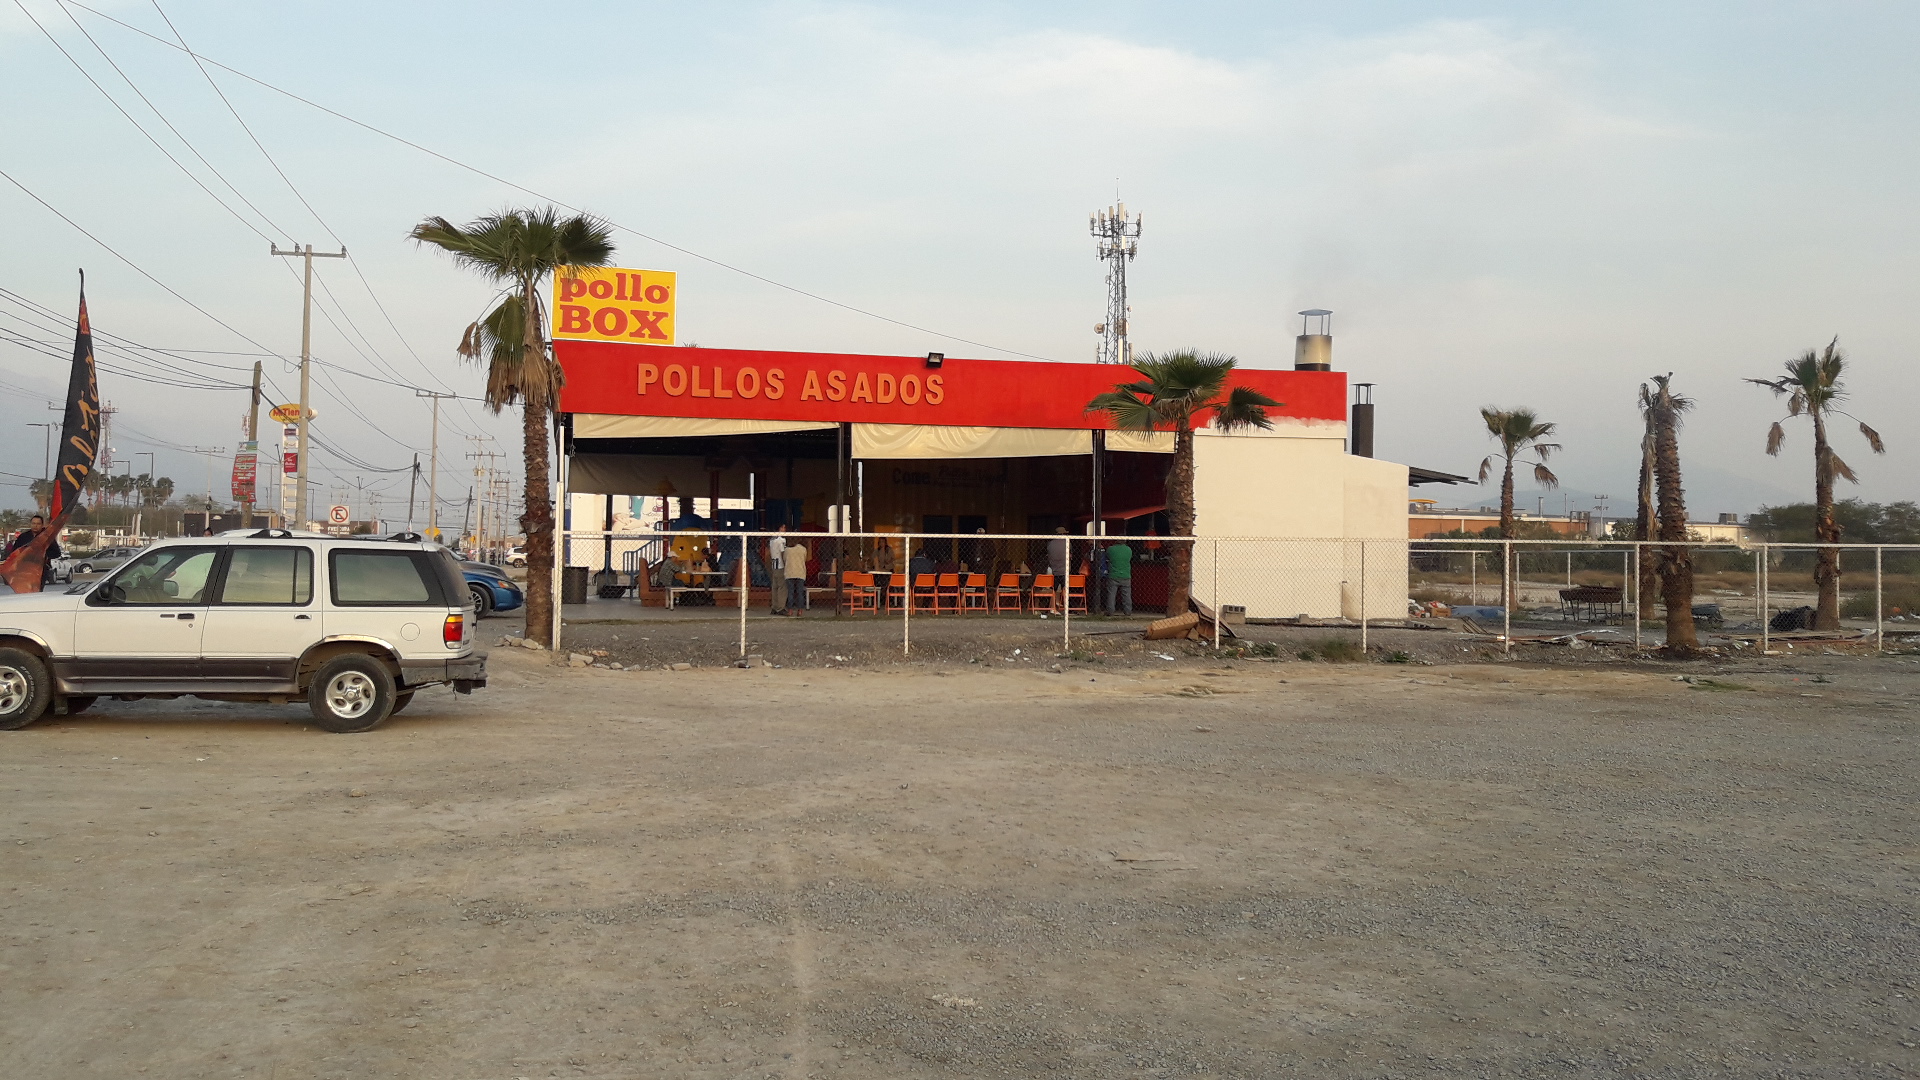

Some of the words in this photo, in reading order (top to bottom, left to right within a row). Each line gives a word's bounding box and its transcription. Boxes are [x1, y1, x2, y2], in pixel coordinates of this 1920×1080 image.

[560, 272, 669, 304] pollo
[559, 304, 669, 340] BOX
[637, 363, 785, 400] POLLOS
[800, 370, 945, 405] ASADOS
